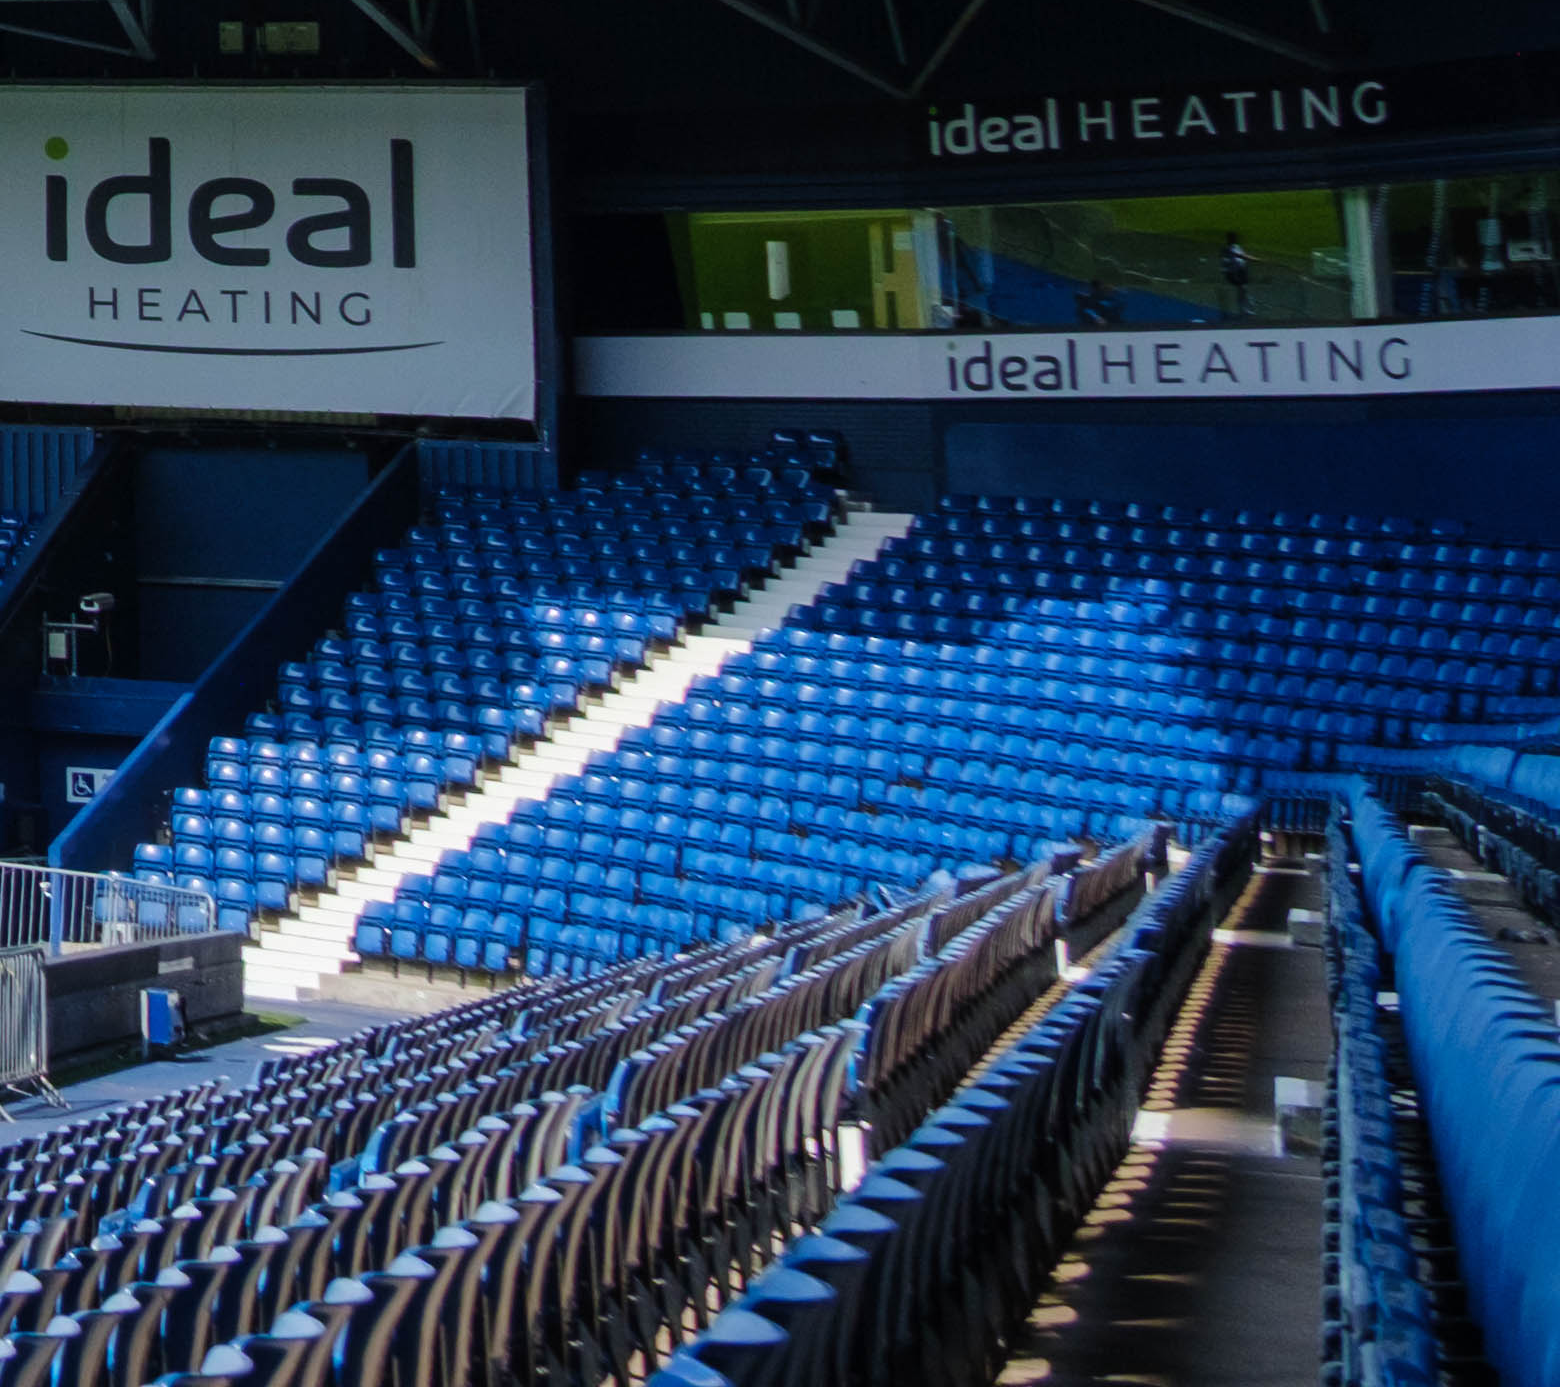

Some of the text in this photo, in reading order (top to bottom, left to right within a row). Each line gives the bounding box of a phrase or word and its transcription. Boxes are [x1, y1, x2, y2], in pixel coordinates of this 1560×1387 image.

[929, 81, 1390, 156] ideal HEATING
[44, 136, 416, 268] ideal
[88, 286, 372, 326] HEATING
[948, 338, 1414, 393] ideal HEATING
